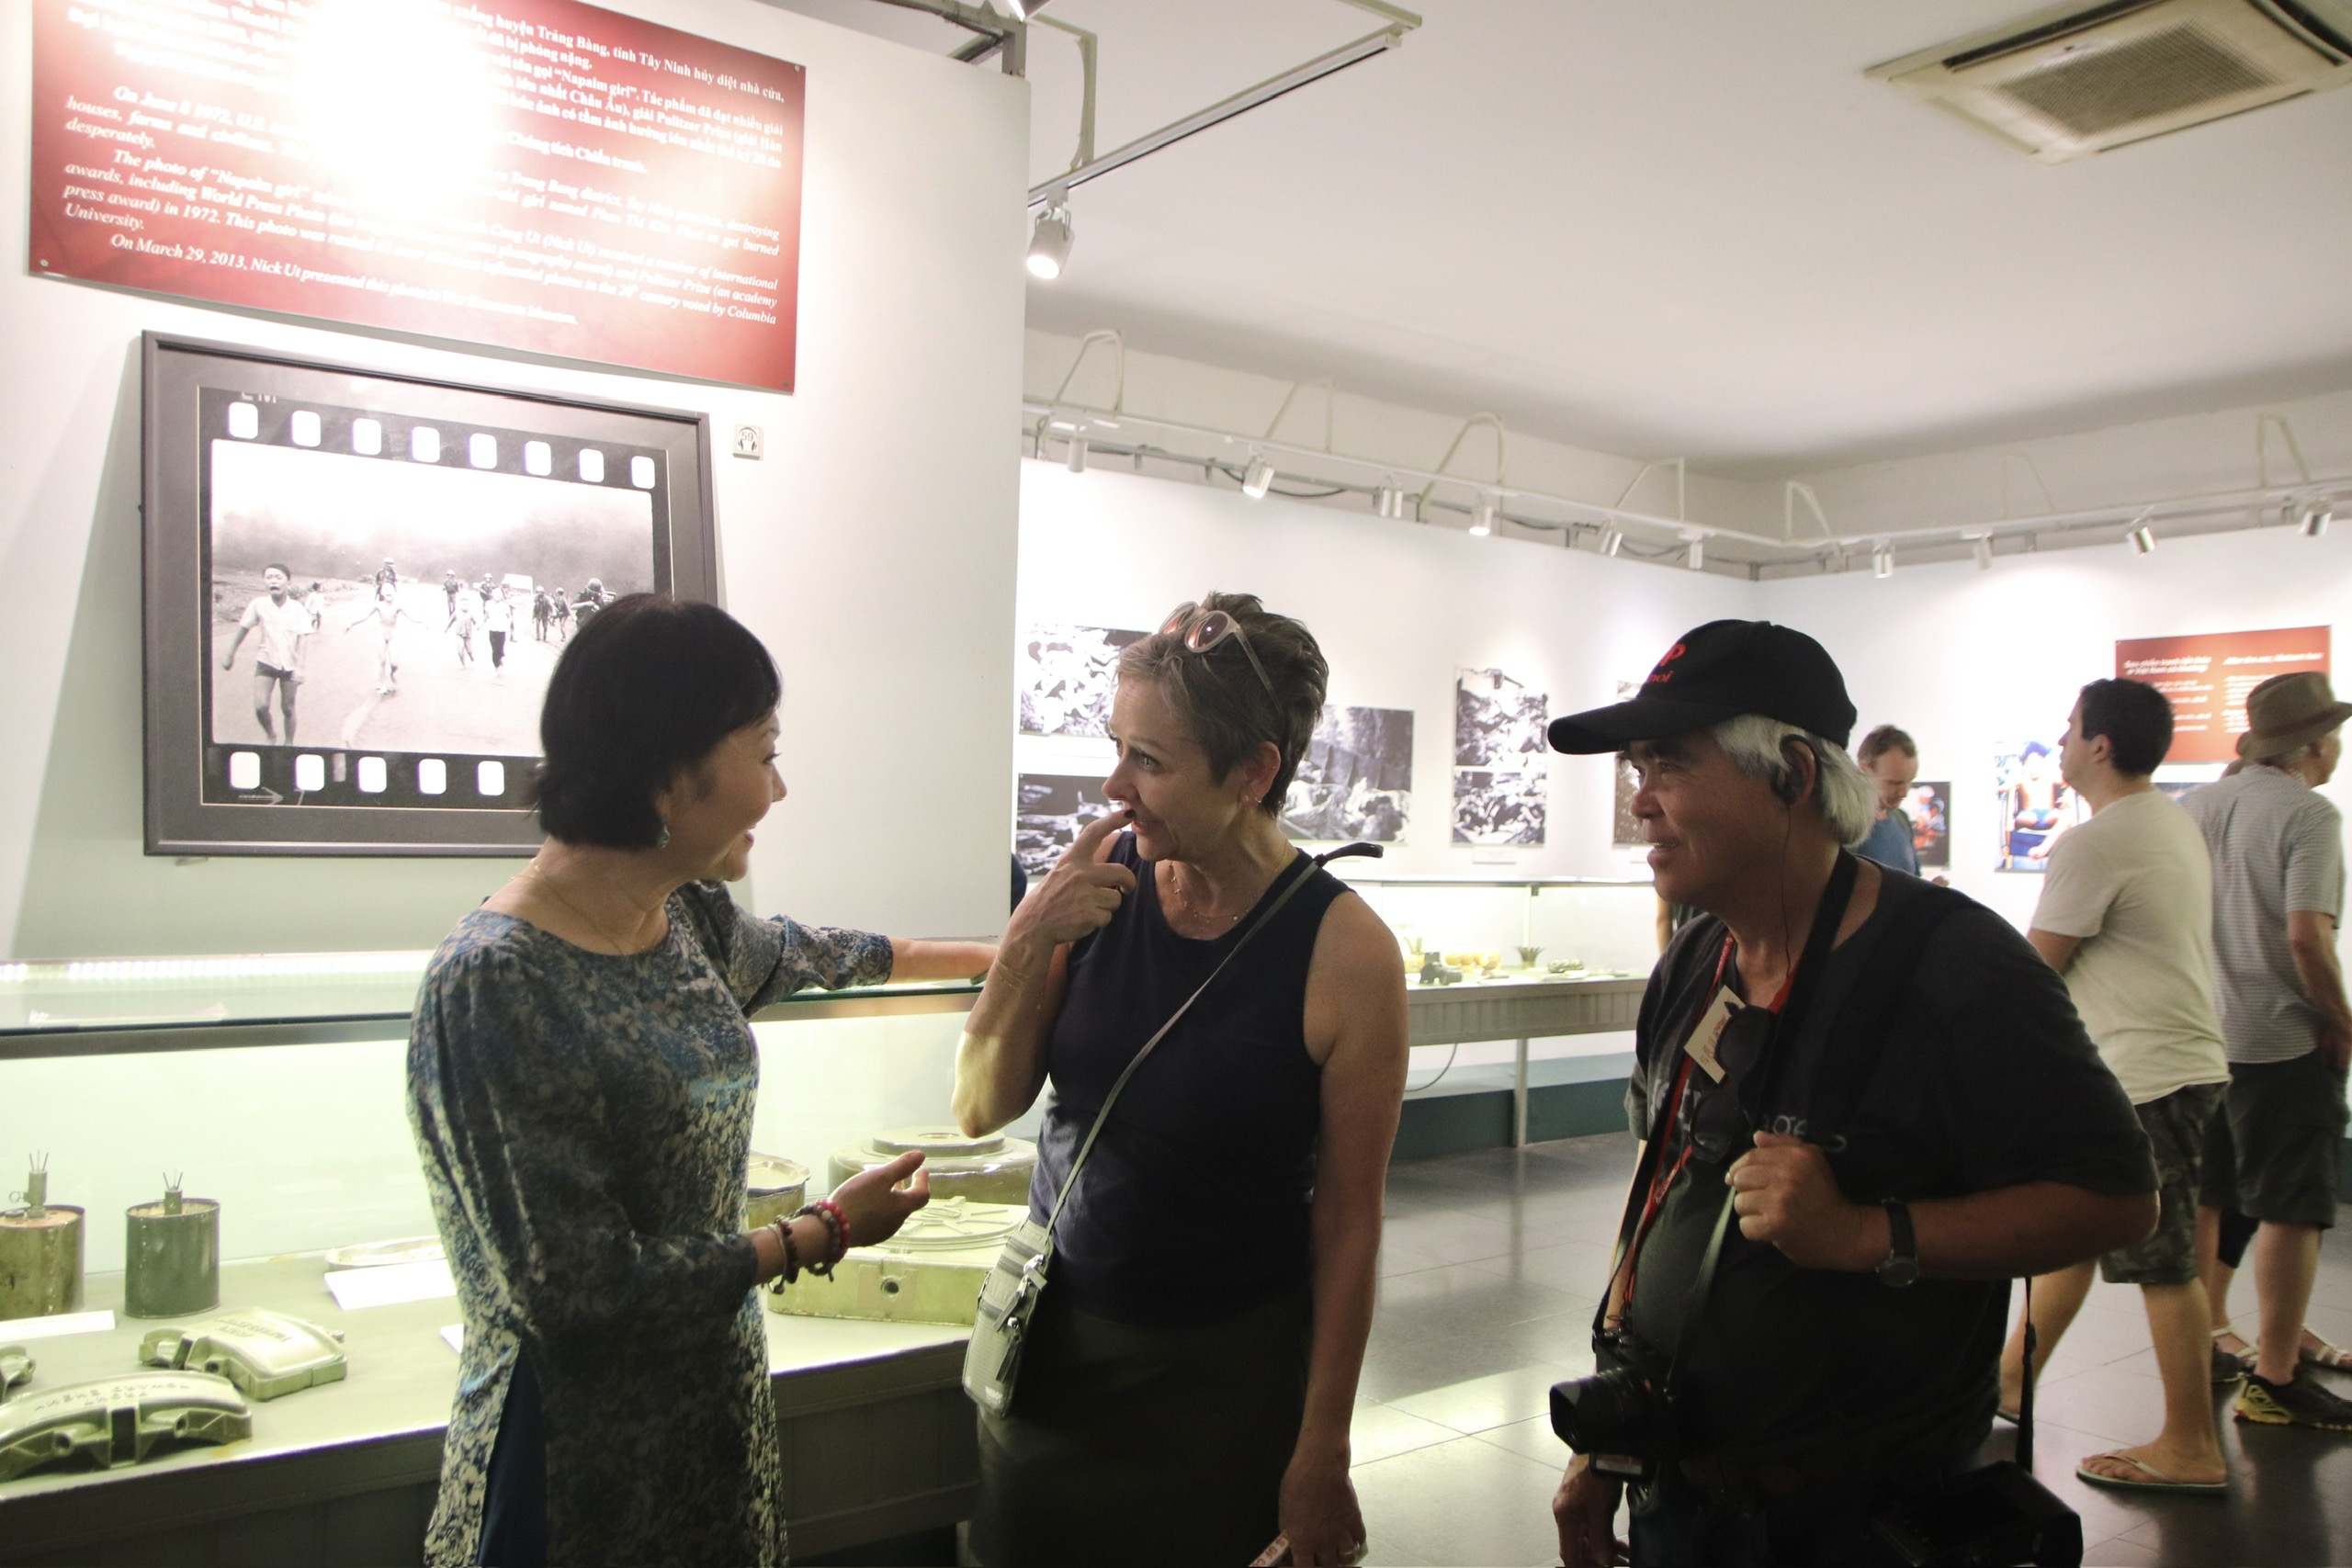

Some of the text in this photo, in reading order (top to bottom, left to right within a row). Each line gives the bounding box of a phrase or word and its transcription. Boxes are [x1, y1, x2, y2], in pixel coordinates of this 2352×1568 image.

[495, 14, 534, 36] huyện
[576, 35, 610, 57] Bàng,
[639, 51, 661, 71] Tây
[663, 58, 691, 76] Ninh
[716, 73, 737, 90] diệt
[740, 81, 760, 95] nhà
[569, 89, 602, 108] Châu
[640, 88, 662, 106] Tác
[731, 114, 763, 130] nhiều
[63, 117, 153, 149] desperately.
[64, 95, 121, 120] houses,
[742, 238, 779, 255] burned
[112, 85, 138, 103] On
[725, 218, 779, 241] destroying
[63, 202, 143, 231] University.
[63, 164, 123, 184] awards,
[128, 174, 197, 200] including
[200, 186, 243, 207] World
[244, 194, 283, 214] Press
[682, 277, 711, 294] Prize
[712, 285, 730, 299] (an
[731, 290, 777, 307] academy
[113, 149, 141, 166] The
[142, 157, 187, 175] photo
[188, 165, 209, 182] of
[697, 265, 714, 279] of
[711, 267, 777, 289] international
[62, 185, 104, 201] press
[107, 194, 161, 213] award)
[163, 201, 178, 216] in
[183, 204, 220, 223] 1972.
[225, 211, 254, 229] This
[255, 219, 297, 236] photo
[299, 228, 326, 242] was
[681, 299, 711, 312] voted
[711, 301, 726, 316] by
[727, 305, 776, 324] Columbia
[109, 233, 133, 250] On
[135, 238, 183, 258] March
[185, 245, 206, 263] 29,
[209, 250, 247, 270] 2013,
[250, 257, 282, 275] Nick
[283, 263, 302, 281] Ut
[300, 269, 366, 288] presented
[741, 432, 753, 442] 59
[1645, 670, 1675, 684] noi
[1659, 642, 1687, 668] P
